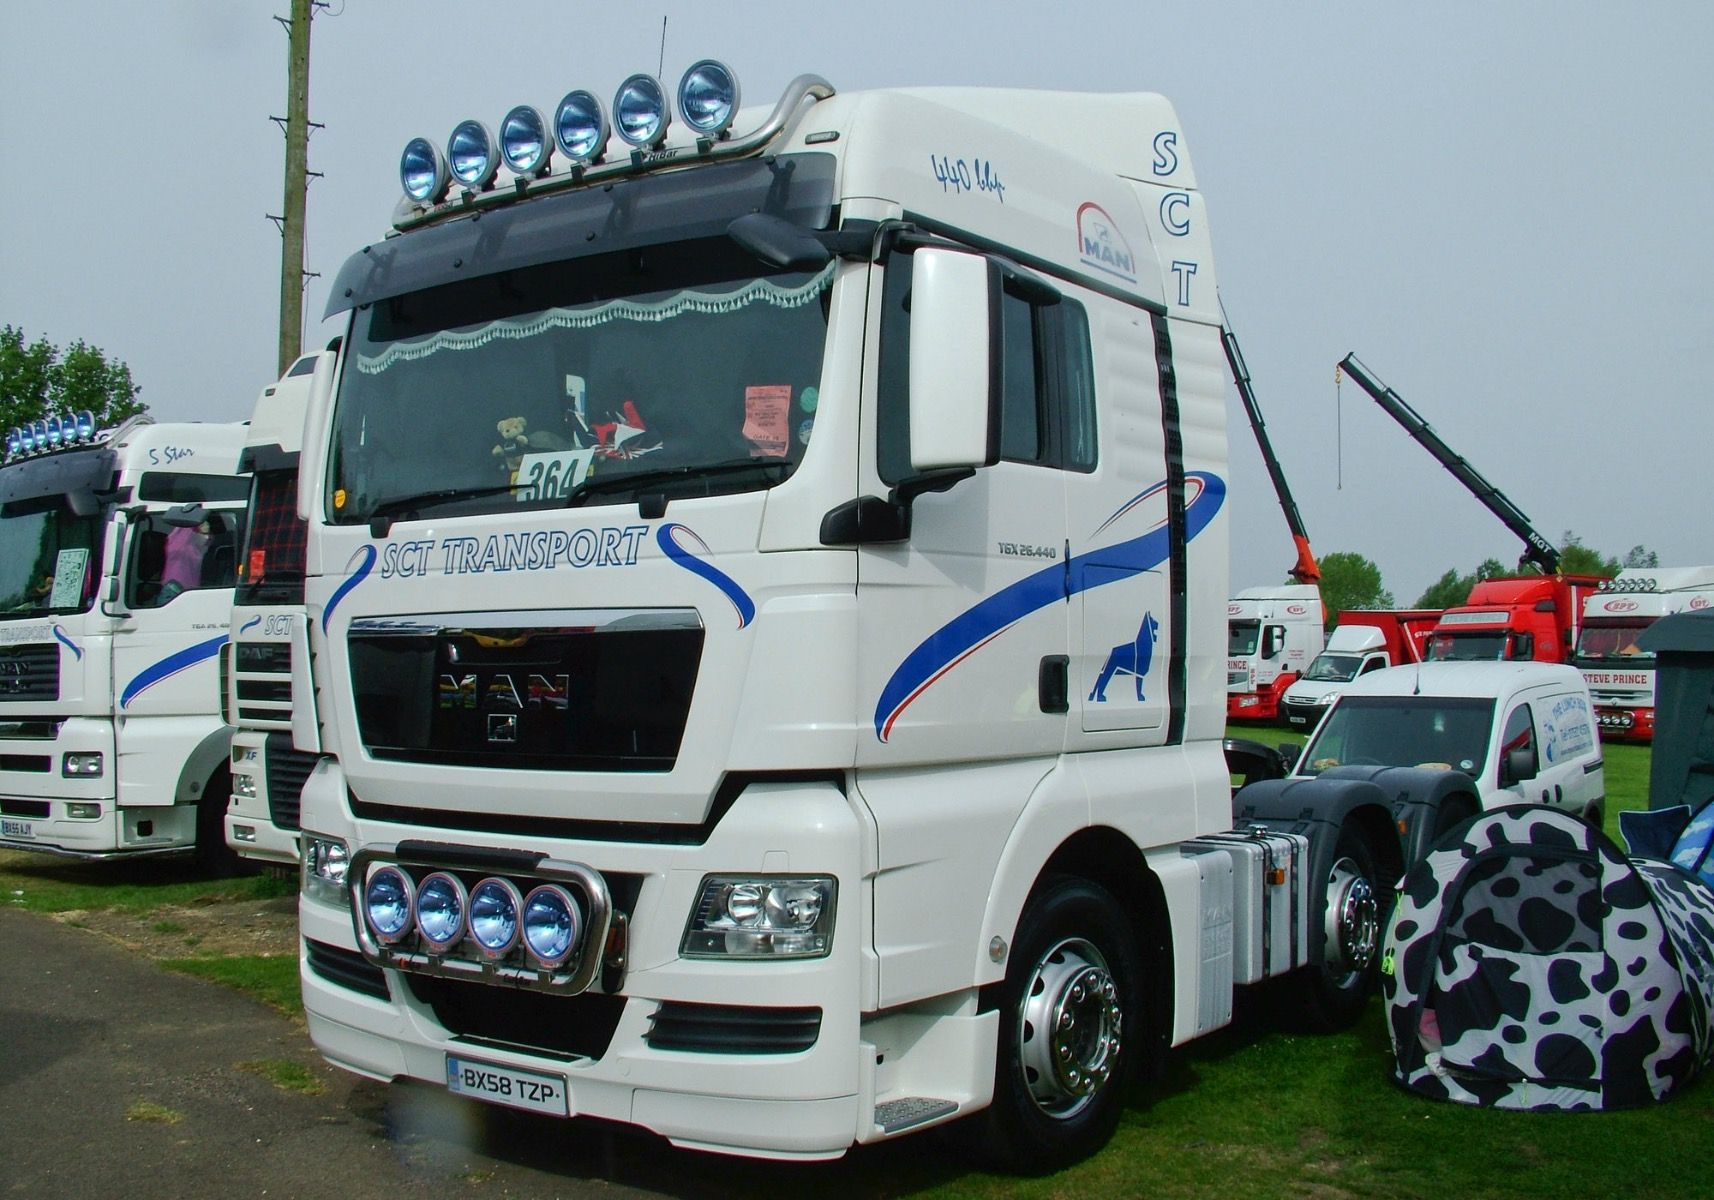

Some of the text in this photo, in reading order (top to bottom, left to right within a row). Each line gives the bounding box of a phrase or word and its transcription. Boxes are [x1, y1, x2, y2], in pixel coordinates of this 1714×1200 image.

[931, 153, 971, 194] 440
[1083, 235, 1131, 273] MAN
[528, 458, 580, 501] 364
[381, 525, 650, 579] SCT TRANSPORT
[264, 614, 293, 636] SCT
[1228, 660, 1247, 670] RINCE
[1583, 673, 1647, 684] STEVE PRINCE
[440, 673, 570, 710] MAN
[245, 751, 258, 761] XF
[464, 1068, 554, 1103] BX58 TZP
